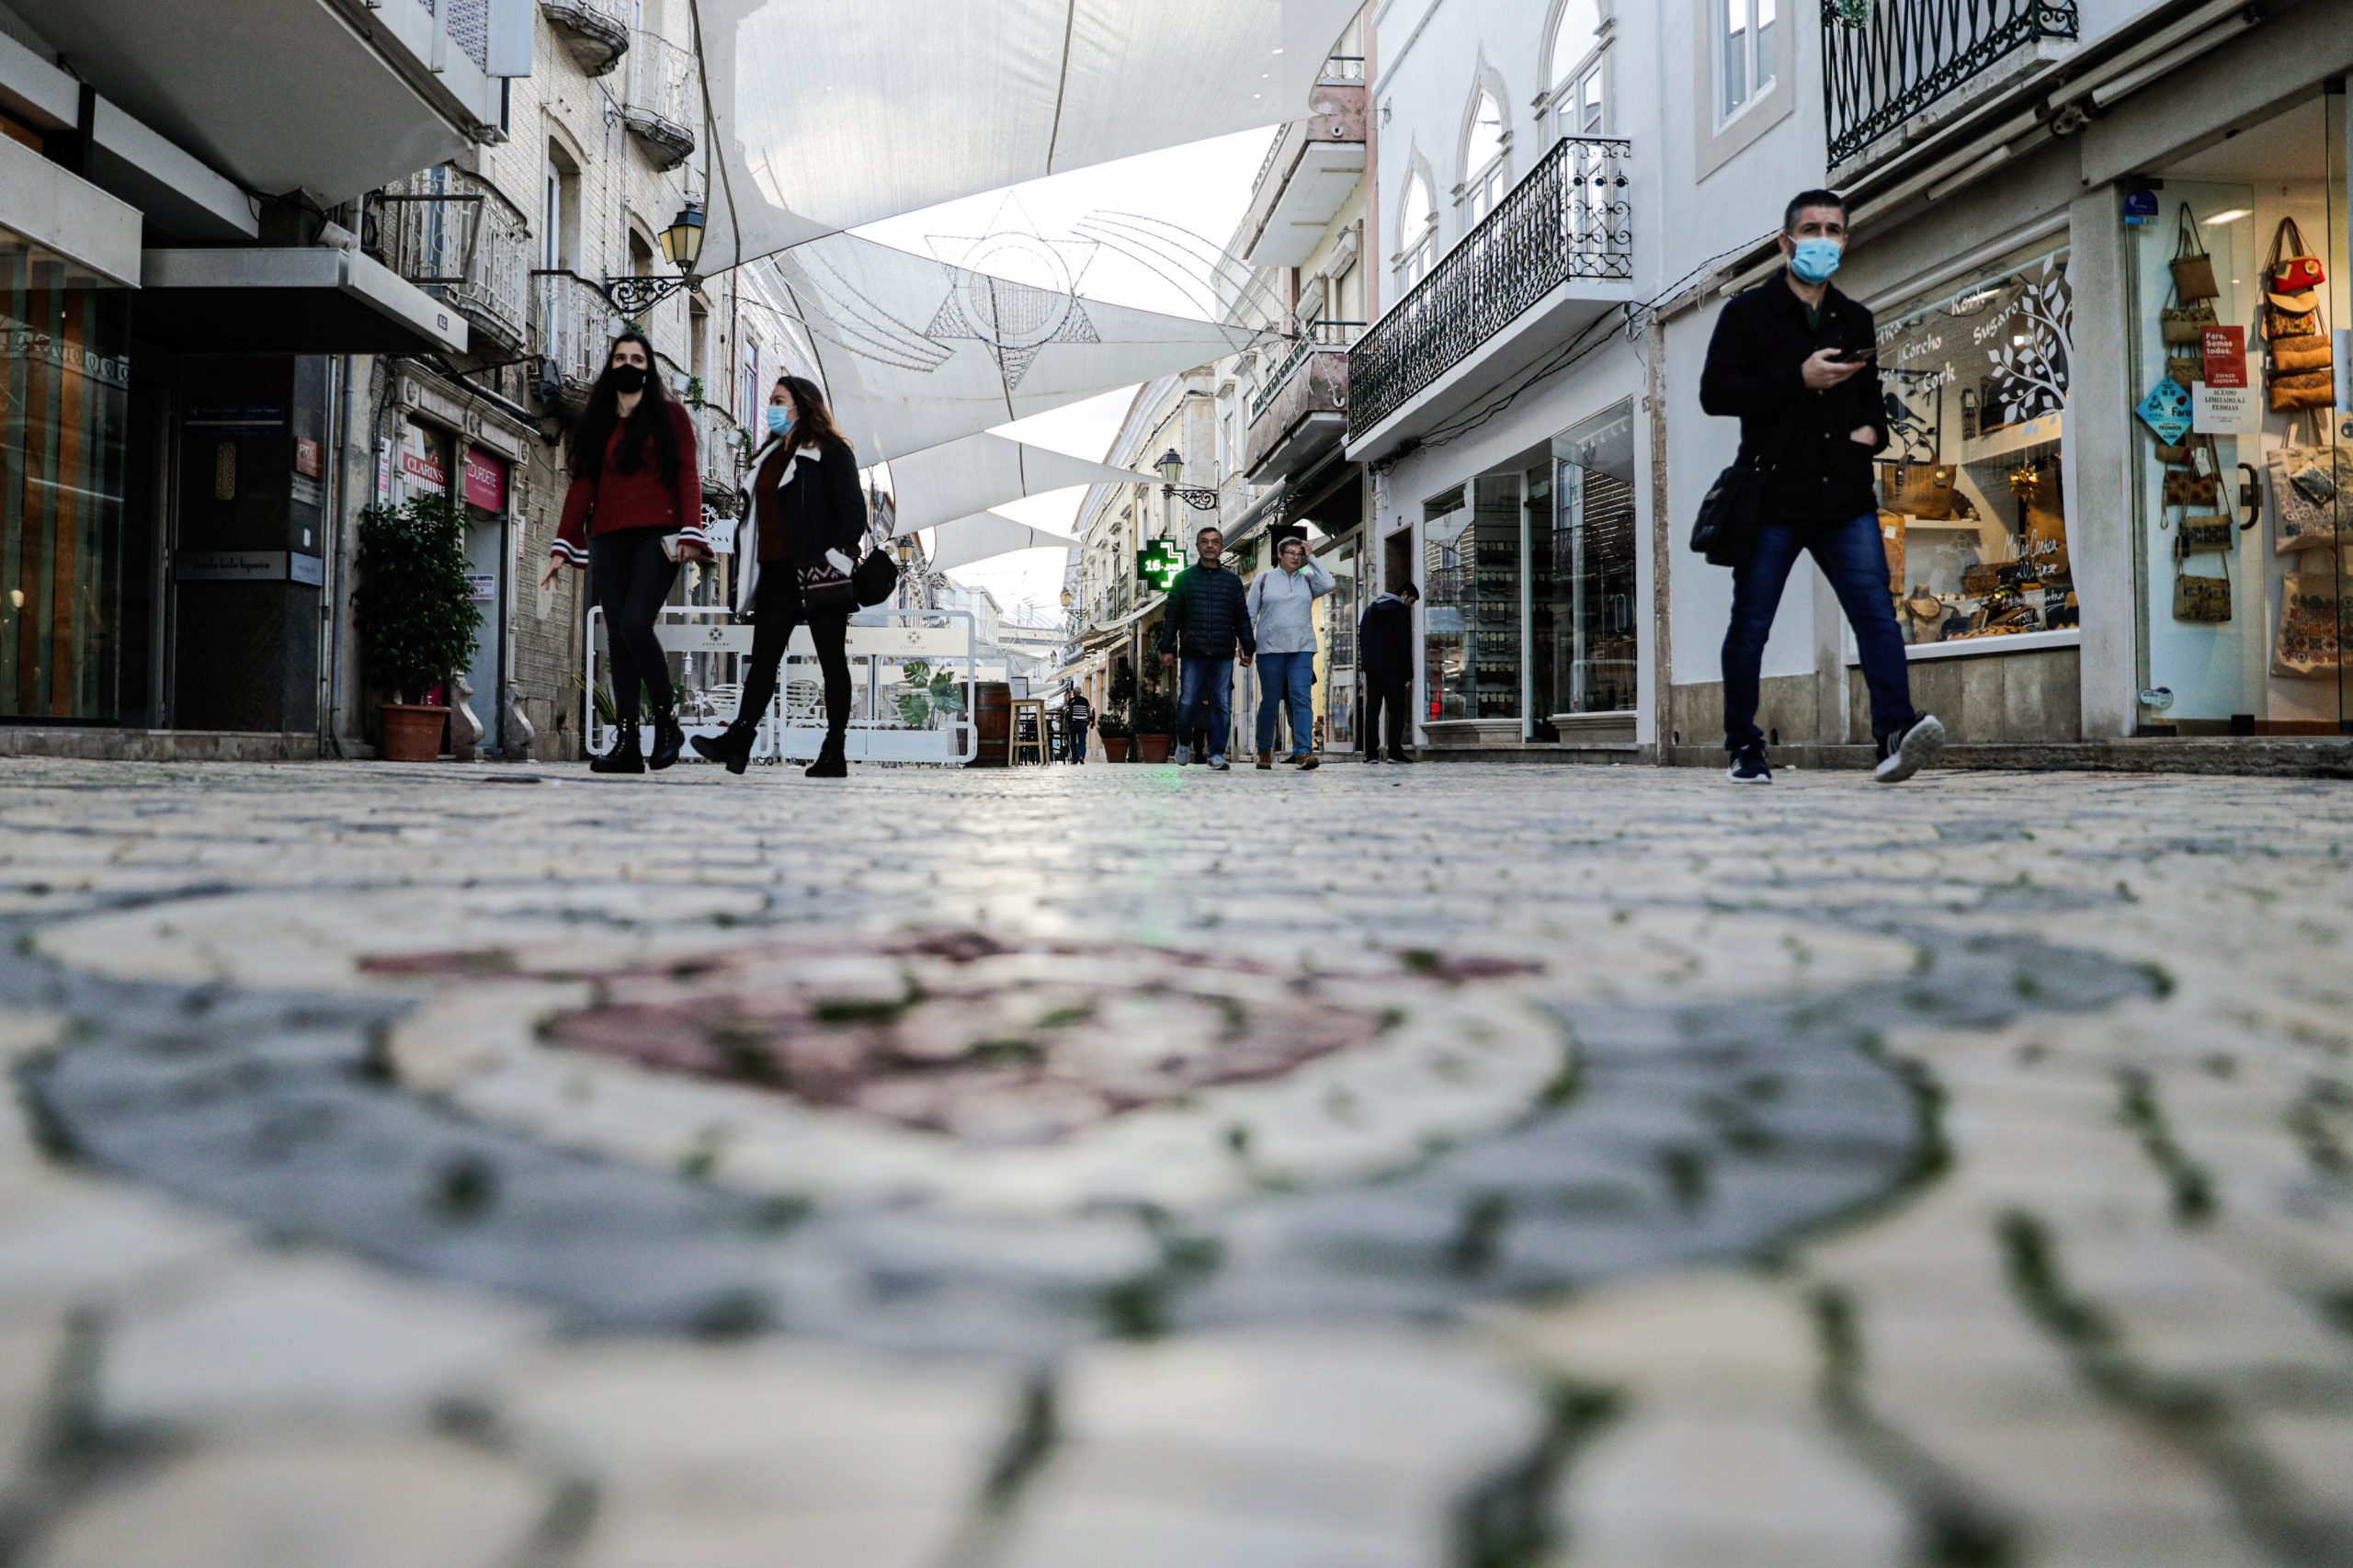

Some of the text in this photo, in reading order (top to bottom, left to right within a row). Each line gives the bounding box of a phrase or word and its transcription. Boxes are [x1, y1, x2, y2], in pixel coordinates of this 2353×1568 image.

[1951, 285, 1985, 316] Kork
[1902, 334, 1942, 360] Corcho
[1923, 361, 1956, 393] Cork
[2172, 407, 2192, 416] Faro
[407, 457, 444, 483] CLARINS
